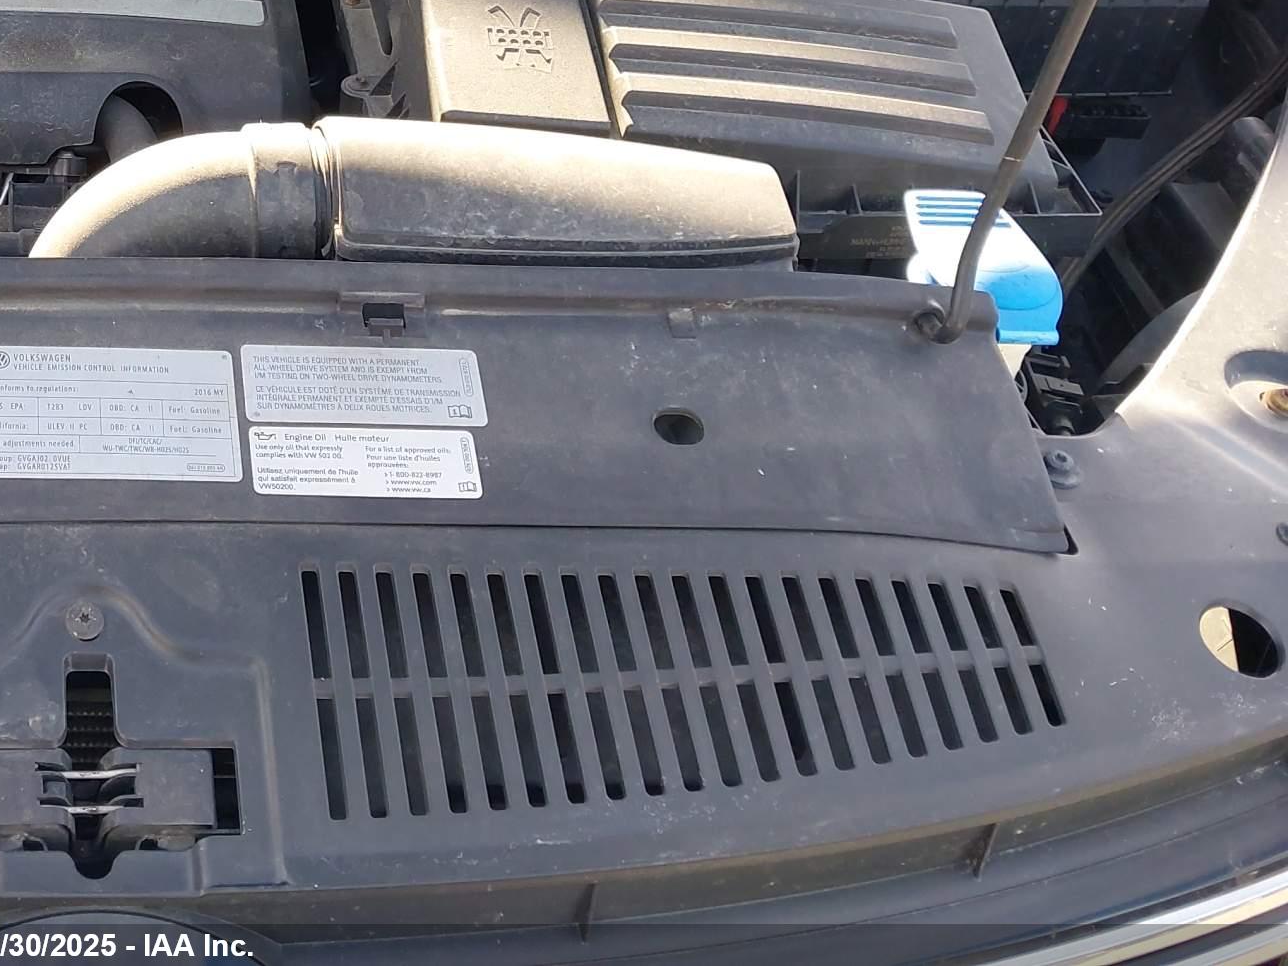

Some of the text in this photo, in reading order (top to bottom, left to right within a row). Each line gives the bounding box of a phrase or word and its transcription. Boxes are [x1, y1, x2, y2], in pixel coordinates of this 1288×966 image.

[13, 353, 71, 362] VOLKSWAGEN
[311, 357, 347, 365] EQUIPPED
[376, 358, 419, 366] PERMANENT
[120, 365, 169, 373] INFORMATION
[253, 364, 296, 372] ALL-WHEEL
[319, 365, 349, 373] SYSTEM
[407, 367, 427, 375] FROM
[358, 374, 380, 382] DRIVE
[194, 388, 211, 396] 2016
[255, 385, 265, 393] CE
[408, 389, 461, 397] TRANSMISSION
[298, 394, 342, 402] PERMANENT
[344, 395, 353, 403] ET
[168, 405, 186, 413] Fuel:
[190, 406, 220, 414] Gasoline
[257, 402, 273, 410] SUR
[365, 404, 390, 412] ROUES
[110, 423, 127, 431] OBD:
[170, 425, 187, 433] Fuel:
[191, 425, 222, 434] Gasoline
[284, 433, 312, 443] Engine
[314, 433, 326, 441] Oil
[335, 434, 357, 442] Huile
[3, 440, 46, 448] adjustments
[311, 445, 343, 453] expressly
[404, 447, 436, 455] approved
[255, 452, 286, 460] complies
[284, 468, 326, 476] uniquement
[258, 474, 269, 482] qui
